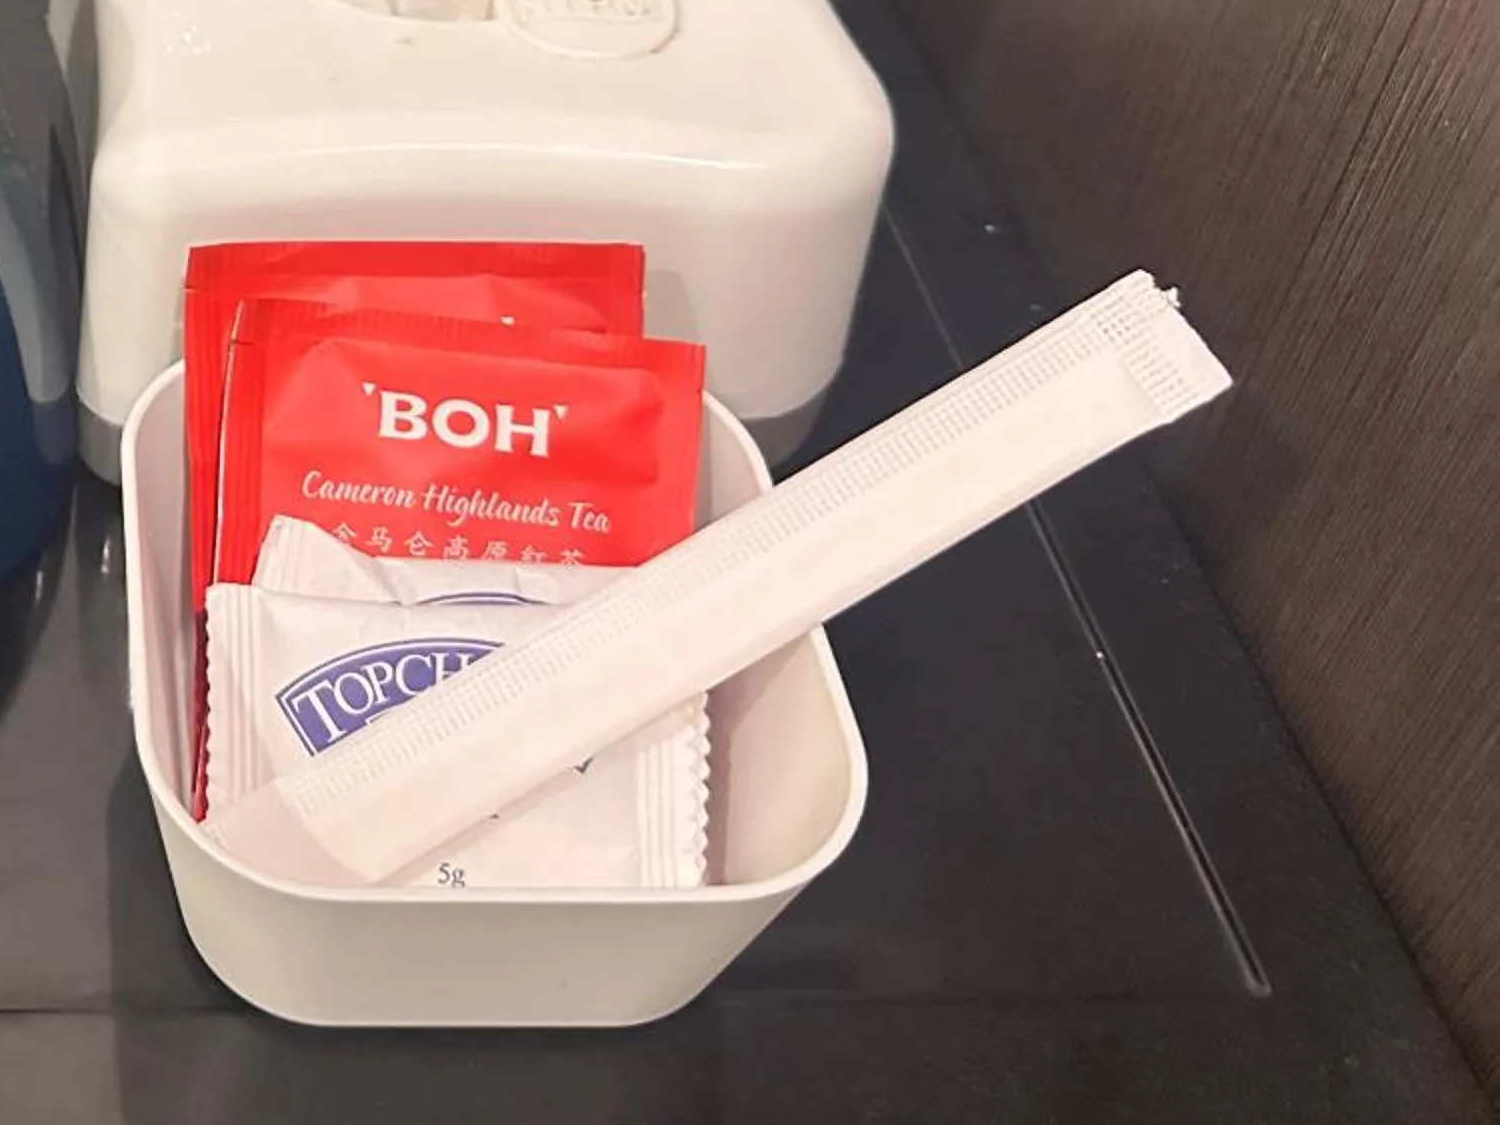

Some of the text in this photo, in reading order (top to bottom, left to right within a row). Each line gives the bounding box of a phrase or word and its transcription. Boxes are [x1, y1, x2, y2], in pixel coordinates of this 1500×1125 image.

[378, 390, 551, 458] BOH
[302, 470, 610, 533] Cameron Highlands Tea
[291, 652, 476, 743] TOPCH
[438, 862, 466, 889] 5g
